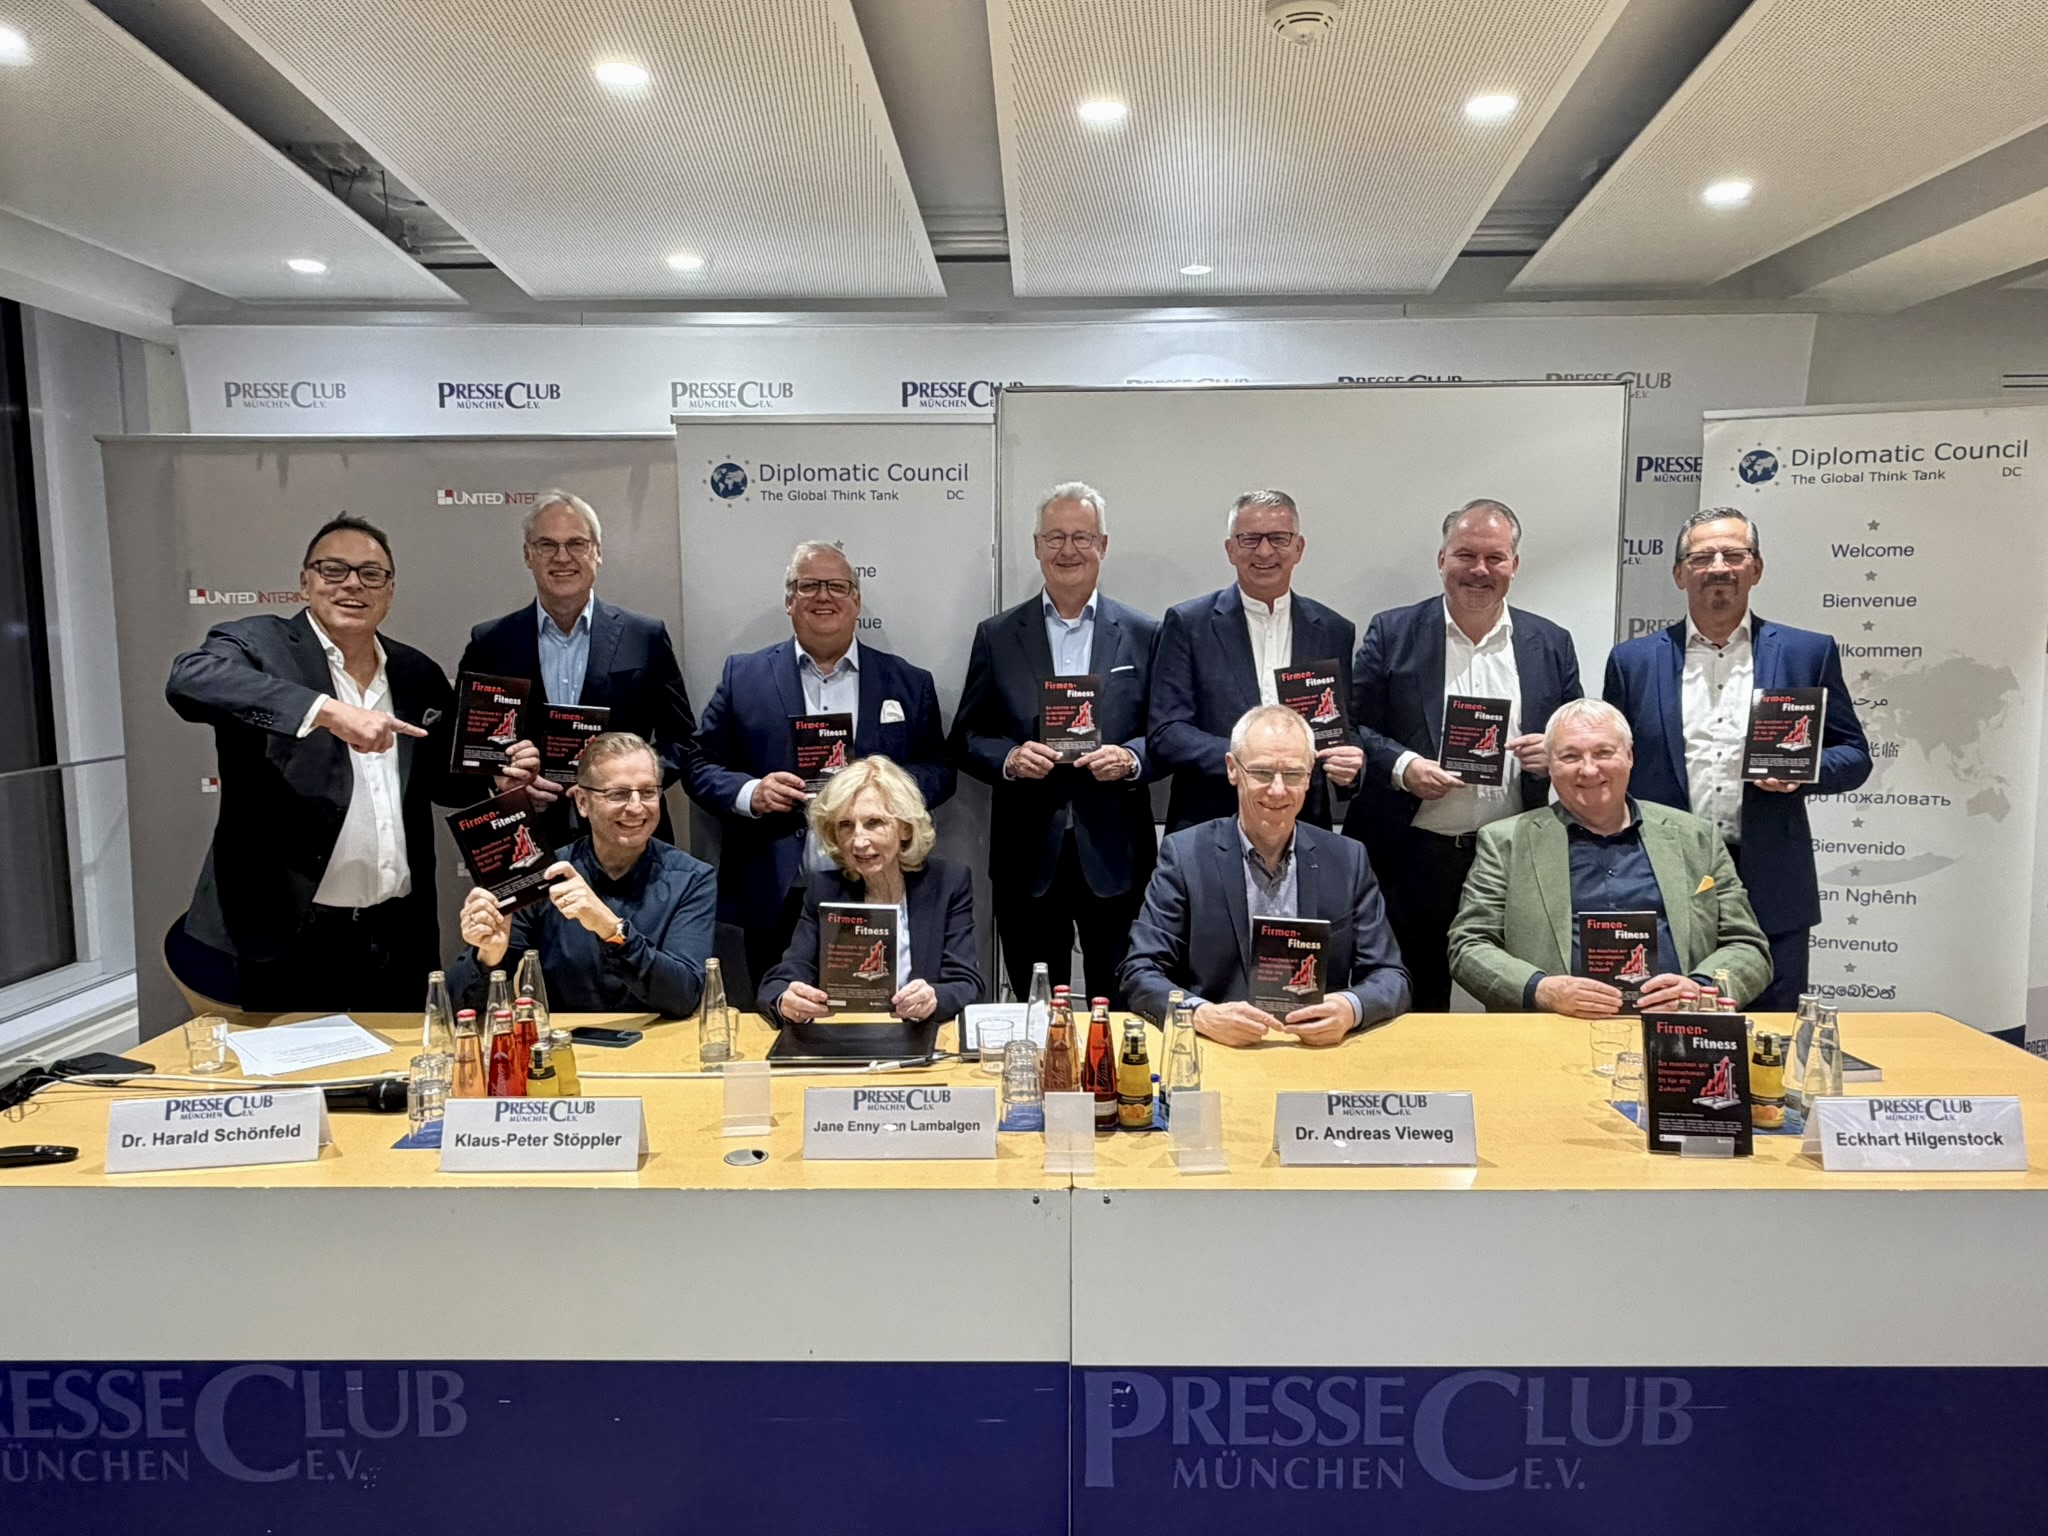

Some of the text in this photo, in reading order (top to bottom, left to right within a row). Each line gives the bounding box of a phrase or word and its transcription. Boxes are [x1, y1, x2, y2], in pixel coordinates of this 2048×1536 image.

[1791, 439, 2029, 470] Diplomatic Council
[759, 463, 969, 486] Diplomatic Council
[1791, 466, 2022, 485] The Global Think Tank DC
[761, 490, 965, 501] The Global Think Tank DC
[1831, 543, 1915, 558] Welcome
[1823, 593, 1917, 608] Bienvenue
[1305, 676, 1335, 687] Fitness
[493, 694, 521, 705] Fitness
[1067, 689, 1095, 698] Fitness
[1762, 695, 1795, 703] irmen-
[1782, 703, 1815, 711] Fitness
[1474, 711, 1503, 721] Fitness
[572, 721, 602, 731] Fitness
[819, 729, 847, 737] Fitness
[490, 810, 527, 830] Fitness
[1811, 838, 1905, 856] Bienvenido
[1846, 888, 1917, 907] Nghênh
[855, 926, 889, 936] Fitness
[1615, 930, 1650, 939] Fitness
[1288, 938, 1321, 950] Fitness
[1808, 934, 1899, 953] Benvenuto
[1656, 1021, 1709, 1035] Firmen-
[1692, 1037, 1738, 1050] Fitness
[813, 1121, 844, 1132] Jane
[848, 1120, 880, 1134] Enny
[911, 1120, 980, 1133] Lambalgen
[122, 1124, 301, 1148] Dr. Harald Schönfeld
[455, 1132, 622, 1149] Klaus-Peter Stöppler
[1296, 1126, 1453, 1143] Dr. Andreas Vieweg
[1836, 1132, 2003, 1149] Eckhart Hilgenstock
[2, 1442, 369, 1482] ÜNCHEN E.V.
[1173, 1450, 1585, 1490] MÜNCHEN E.V.
